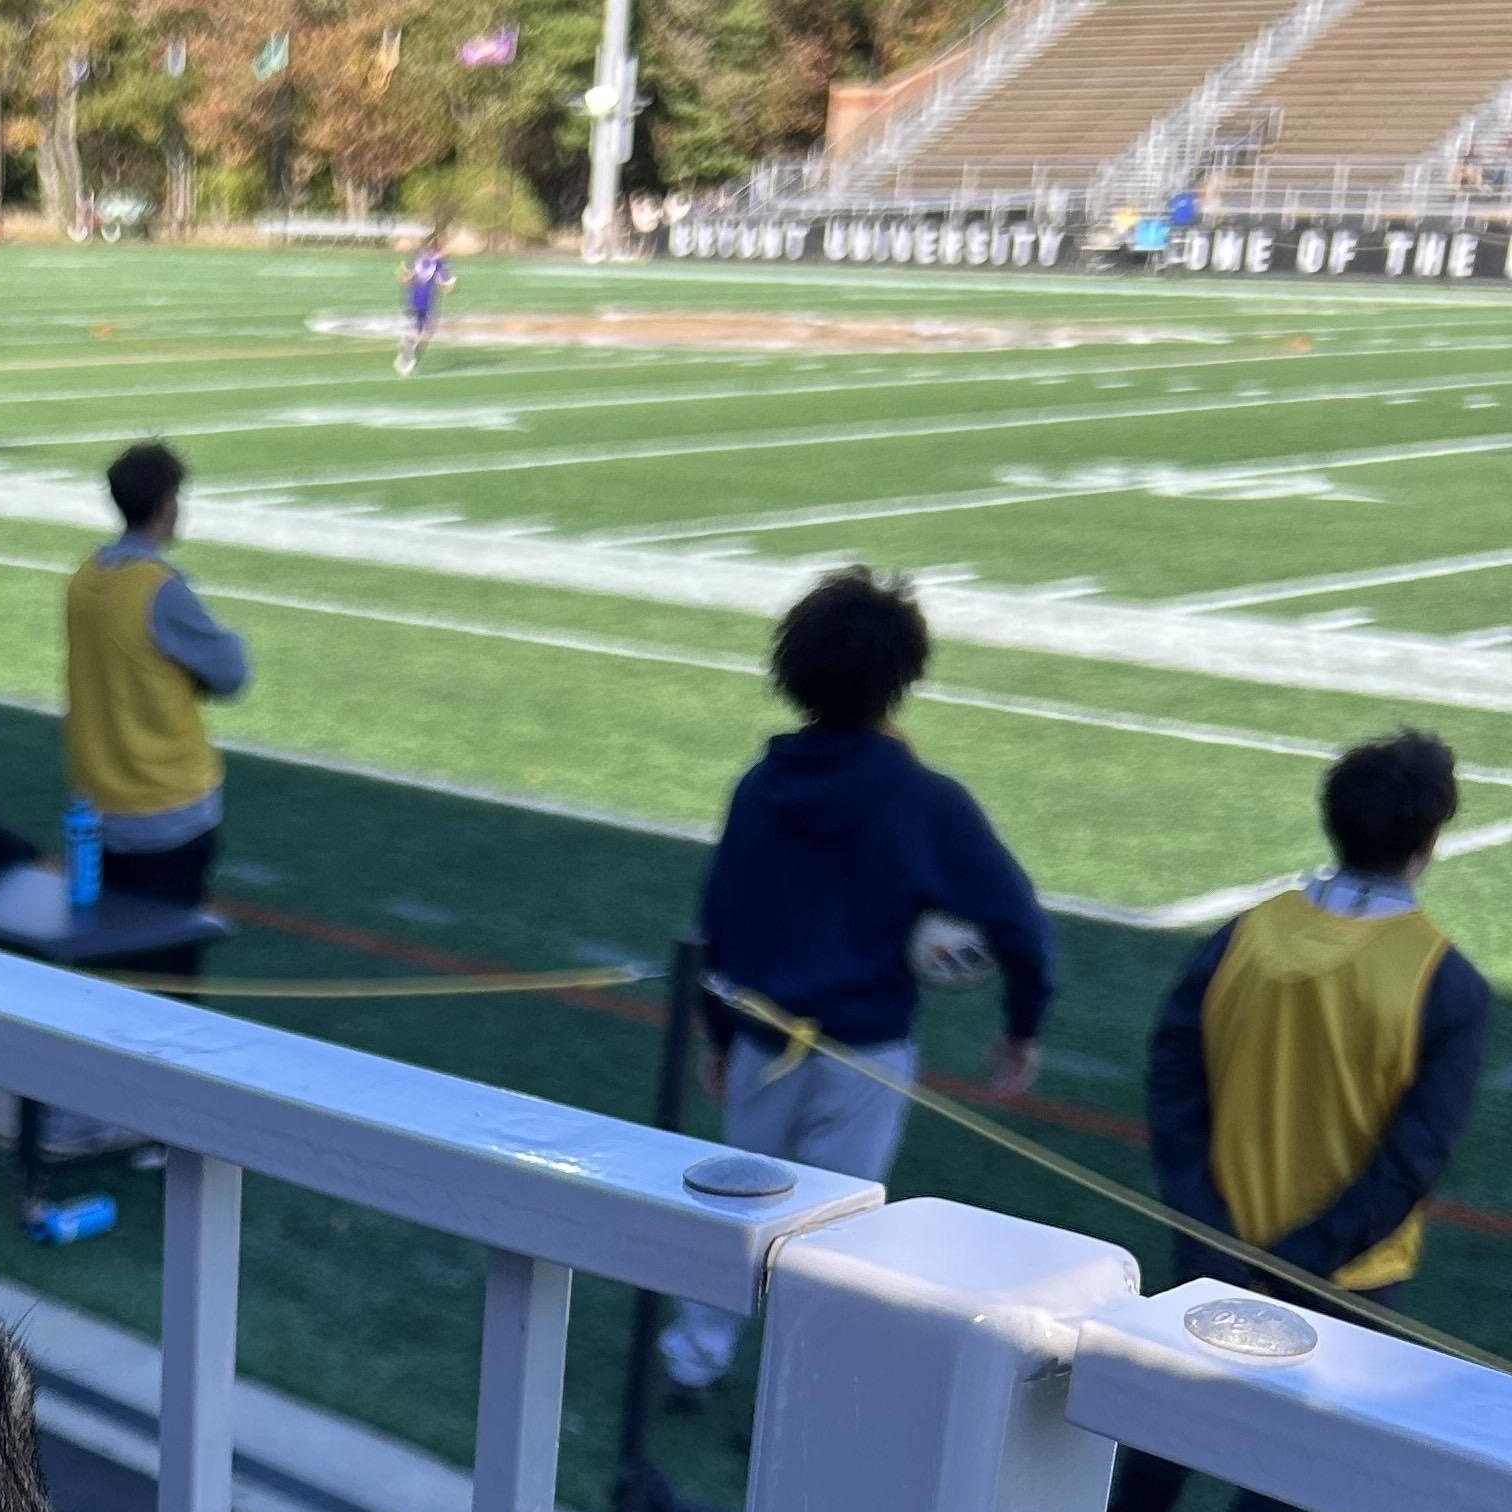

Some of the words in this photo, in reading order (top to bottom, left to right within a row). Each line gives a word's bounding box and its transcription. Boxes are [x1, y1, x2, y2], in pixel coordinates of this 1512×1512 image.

[824, 218, 1065, 266] UNIVERSITY
[1188, 229, 1273, 272] ONE
[1297, 229, 1359, 274] OF
[1385, 231, 1479, 277] THE
